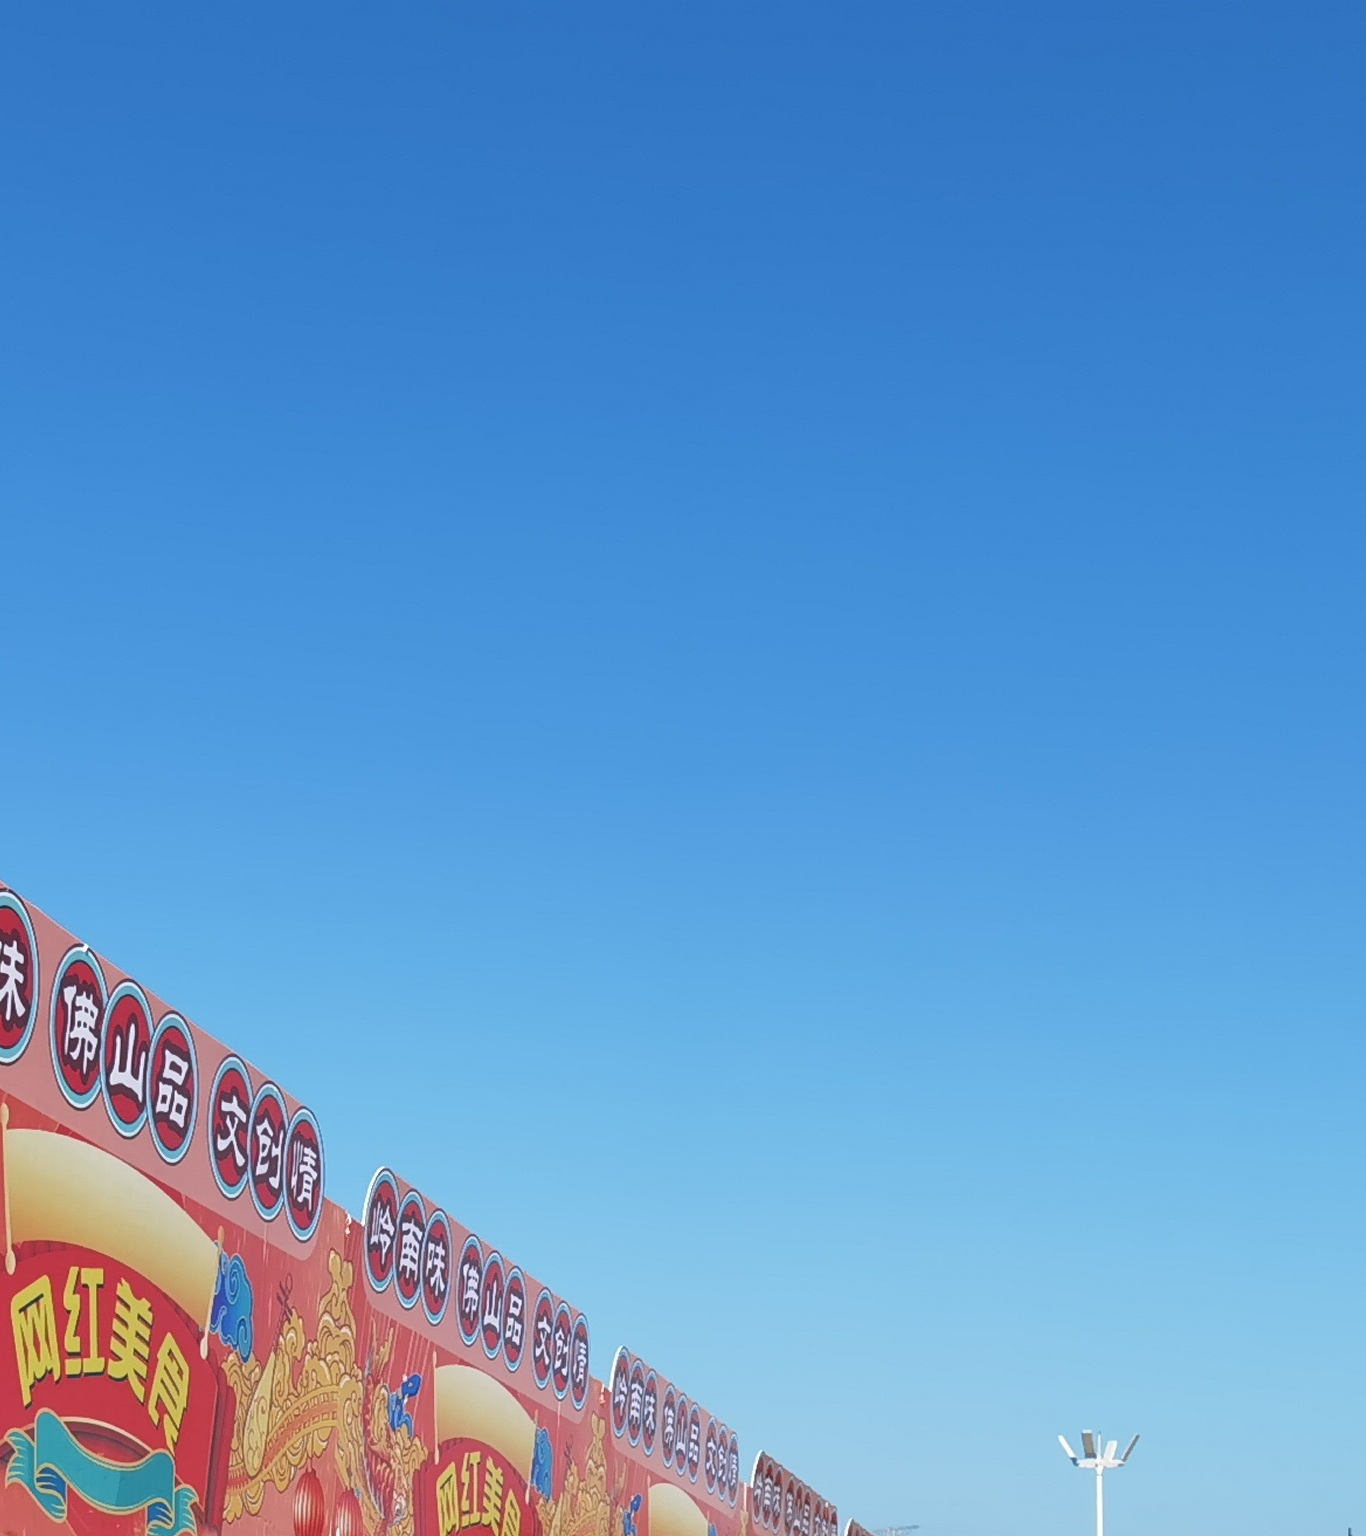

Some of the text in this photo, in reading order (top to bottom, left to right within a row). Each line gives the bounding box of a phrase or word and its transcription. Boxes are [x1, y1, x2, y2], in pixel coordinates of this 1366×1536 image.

[62, 984, 190, 1130] 佛山品
[216, 1096, 320, 1212] 文创情
[10, 1266, 191, 1453] 网红美食
[370, 1201, 445, 1297] 岭南味
[462, 1261, 524, 1346] 佛山品
